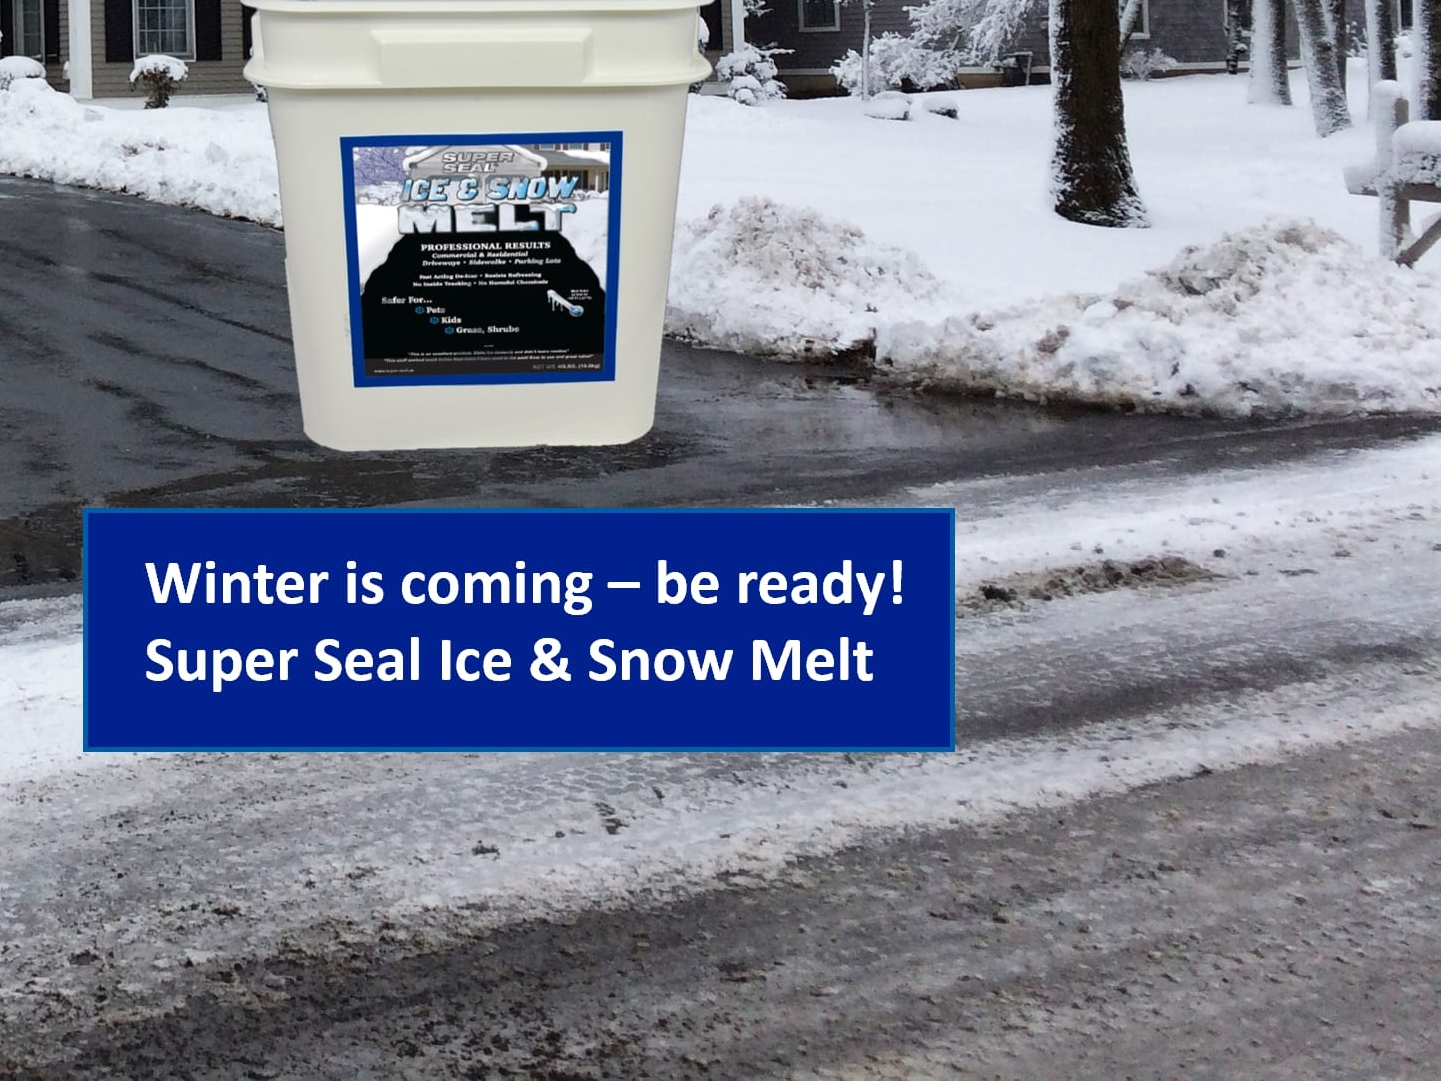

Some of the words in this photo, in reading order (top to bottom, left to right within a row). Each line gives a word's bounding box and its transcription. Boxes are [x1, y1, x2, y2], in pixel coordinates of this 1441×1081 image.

[442, 151, 514, 163] SUPER
[401, 177, 450, 202] ICE
[457, 175, 479, 201] &
[486, 175, 579, 201] SNOW
[397, 203, 577, 234] MELT
[421, 243, 502, 251] PROFESSIONAL
[505, 241, 551, 249] RESULTS
[426, 306, 446, 314] Pets
[441, 316, 462, 324] Kids
[487, 325, 520, 333] Shrubs
